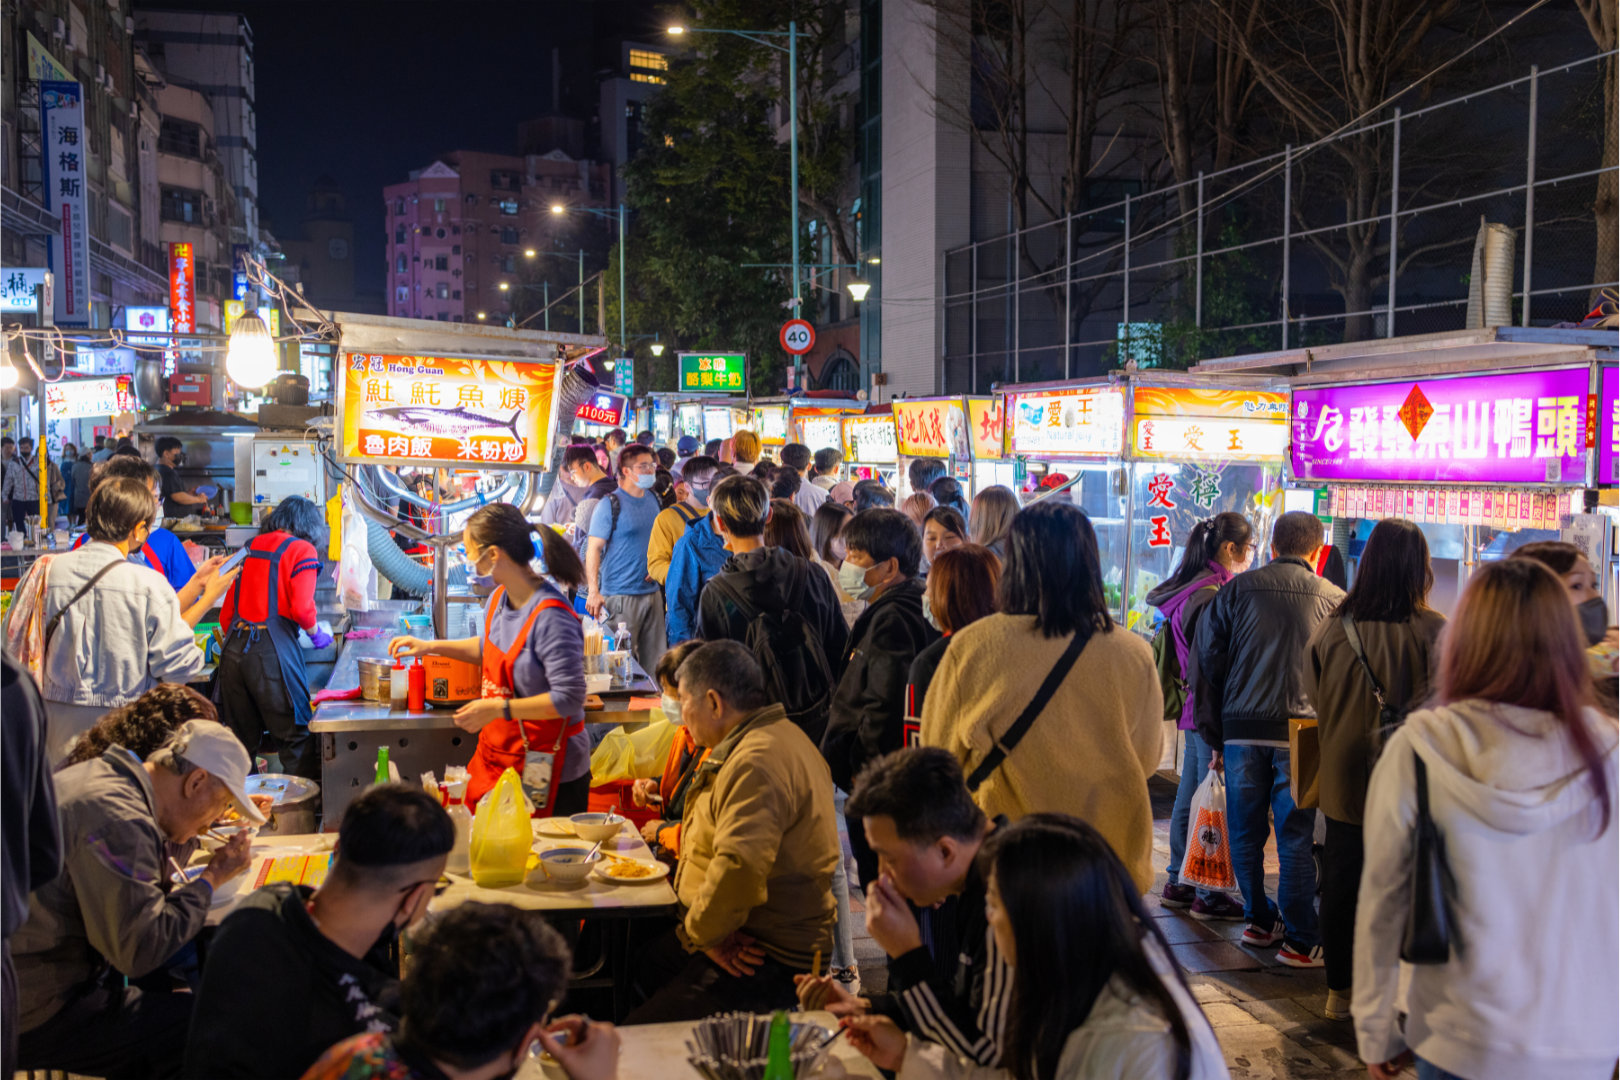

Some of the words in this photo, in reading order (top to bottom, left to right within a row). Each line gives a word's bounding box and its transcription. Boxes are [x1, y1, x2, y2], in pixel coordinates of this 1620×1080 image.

[58, 126, 80, 198] 海格斯
[787, 331, 808, 343] 40
[389, 364, 414, 374] Hong
[417, 366, 443, 375] Guan
[686, 372, 742, 387] 酪梨牛奶
[906, 408, 946, 448] 地瓜球
[1143, 420, 1155, 450] 愛玉
[1184, 425, 1243, 451] 愛玉
[364, 434, 432, 457] 魯肉飯
[457, 440, 523, 461] 米粉炒
[1148, 473, 1175, 547] 愛玉
